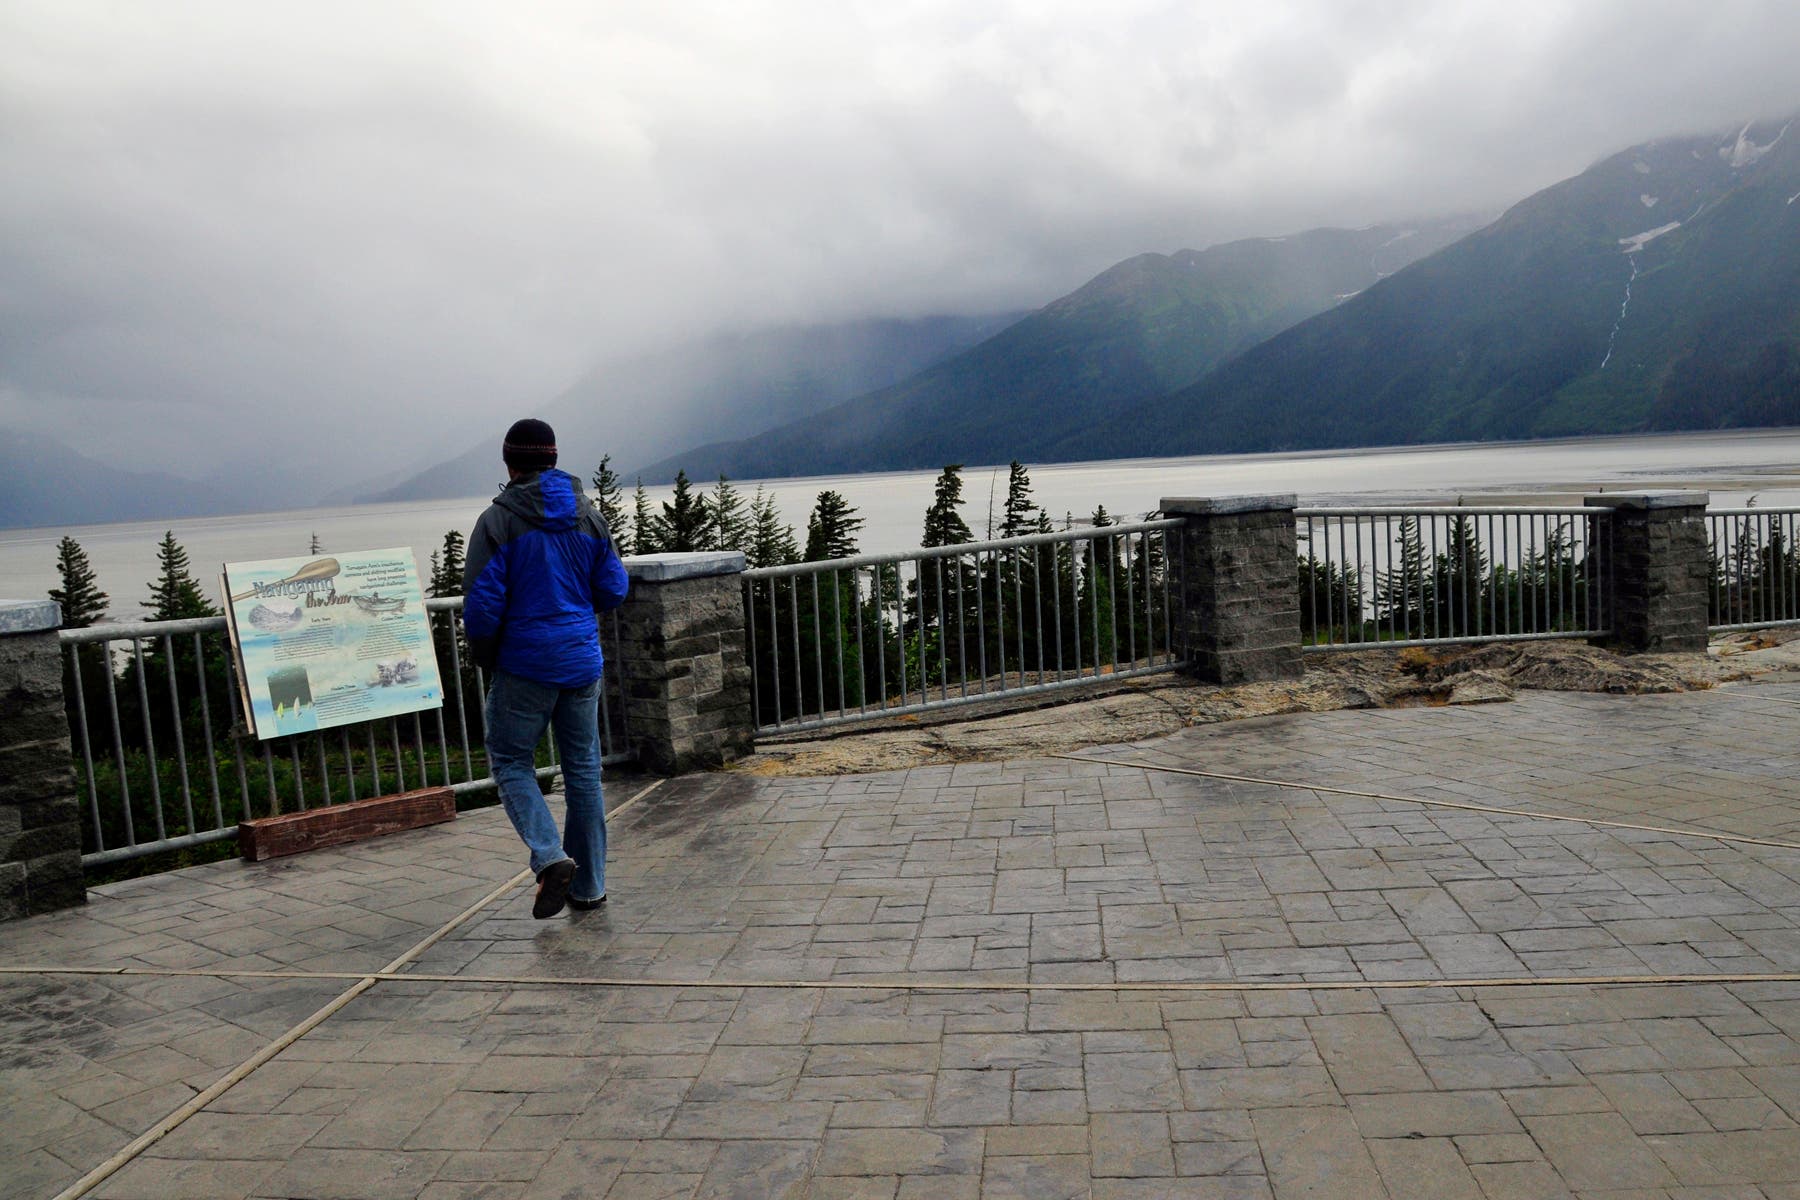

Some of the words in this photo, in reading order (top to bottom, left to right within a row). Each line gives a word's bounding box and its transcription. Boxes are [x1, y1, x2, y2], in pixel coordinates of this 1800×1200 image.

[252, 577, 335, 600] Navigating
[305, 592, 324, 608] the
[324, 589, 352, 607] Arm
